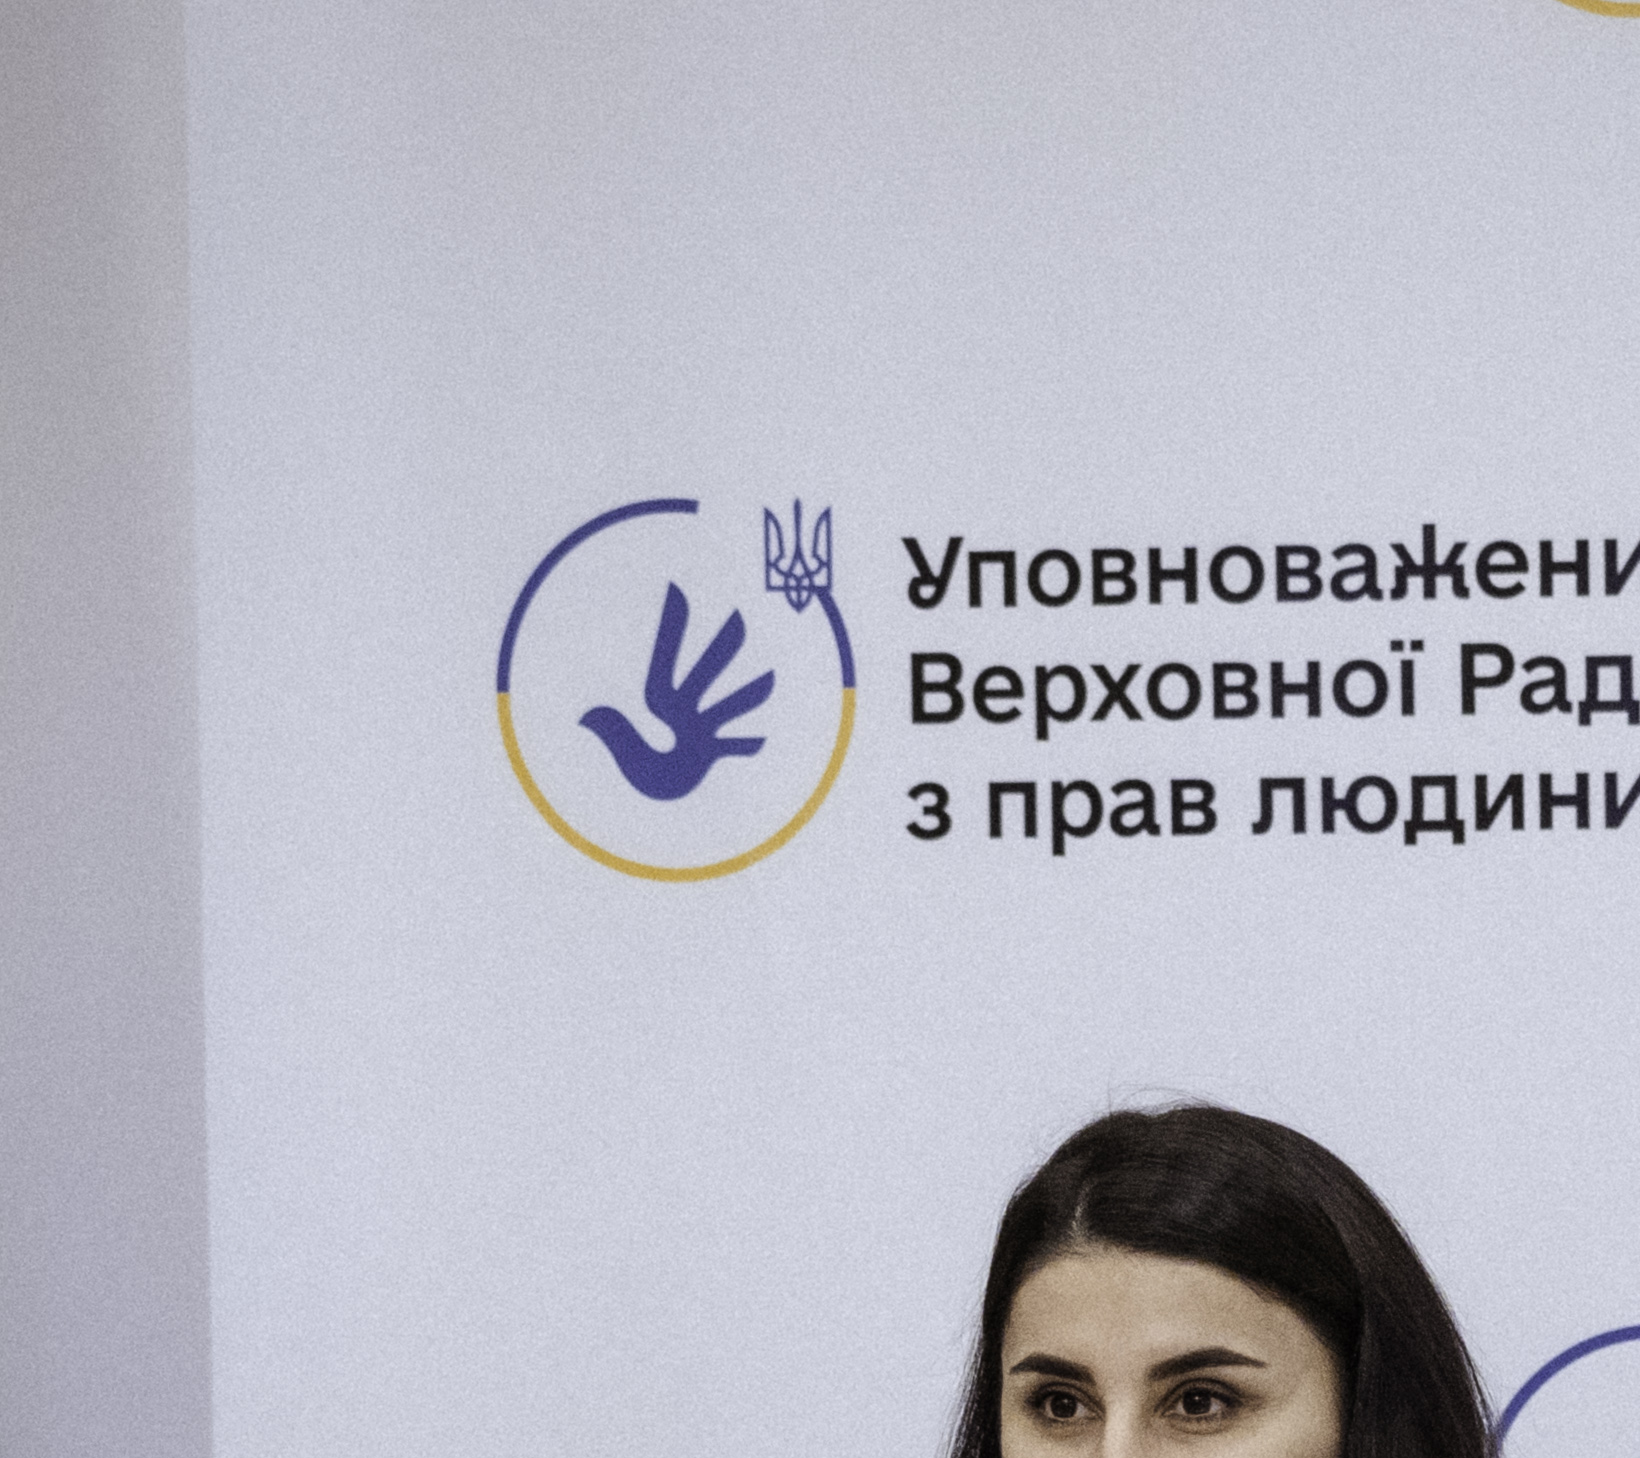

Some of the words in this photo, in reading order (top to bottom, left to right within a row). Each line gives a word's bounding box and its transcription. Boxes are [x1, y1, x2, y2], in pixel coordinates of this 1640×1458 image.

[910, 639, 1424, 741] Верховної
[907, 782, 952, 841] з
[988, 777, 1217, 856] прав
